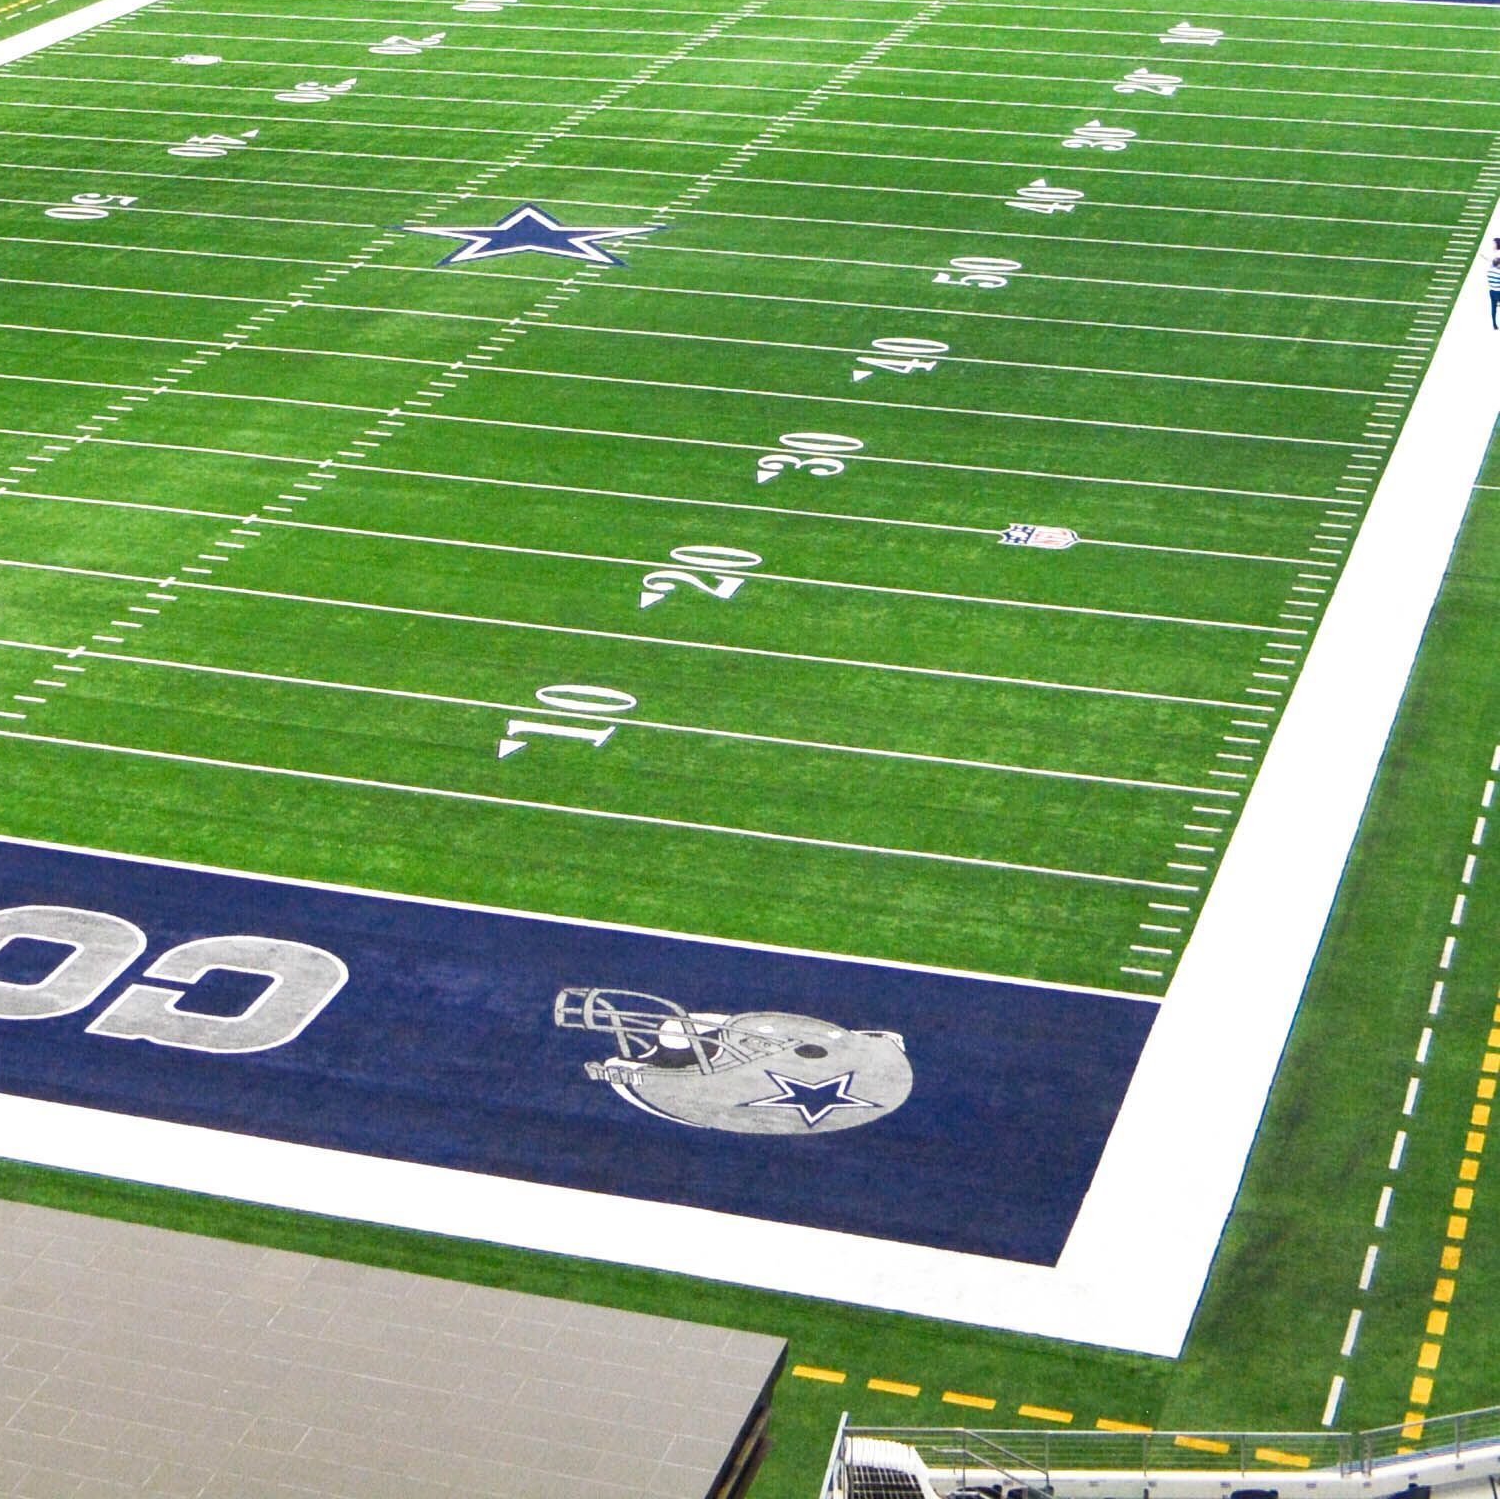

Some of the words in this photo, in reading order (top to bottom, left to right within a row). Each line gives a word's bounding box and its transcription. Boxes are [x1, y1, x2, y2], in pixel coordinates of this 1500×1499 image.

[368, 34, 440, 55] 20
[1159, 26, 1223, 47] 10
[274, 81, 352, 102] 30
[1113, 73, 1182, 96] 20
[167, 134, 247, 157] 40
[1061, 126, 1137, 151] 30
[44, 193, 138, 220] 50
[1005, 187, 1084, 214] 40
[932, 257, 1022, 288] 50
[856, 338, 949, 374] 40
[757, 433, 864, 476] 30
[642, 546, 763, 600] 20
[507, 685, 637, 748] 10
